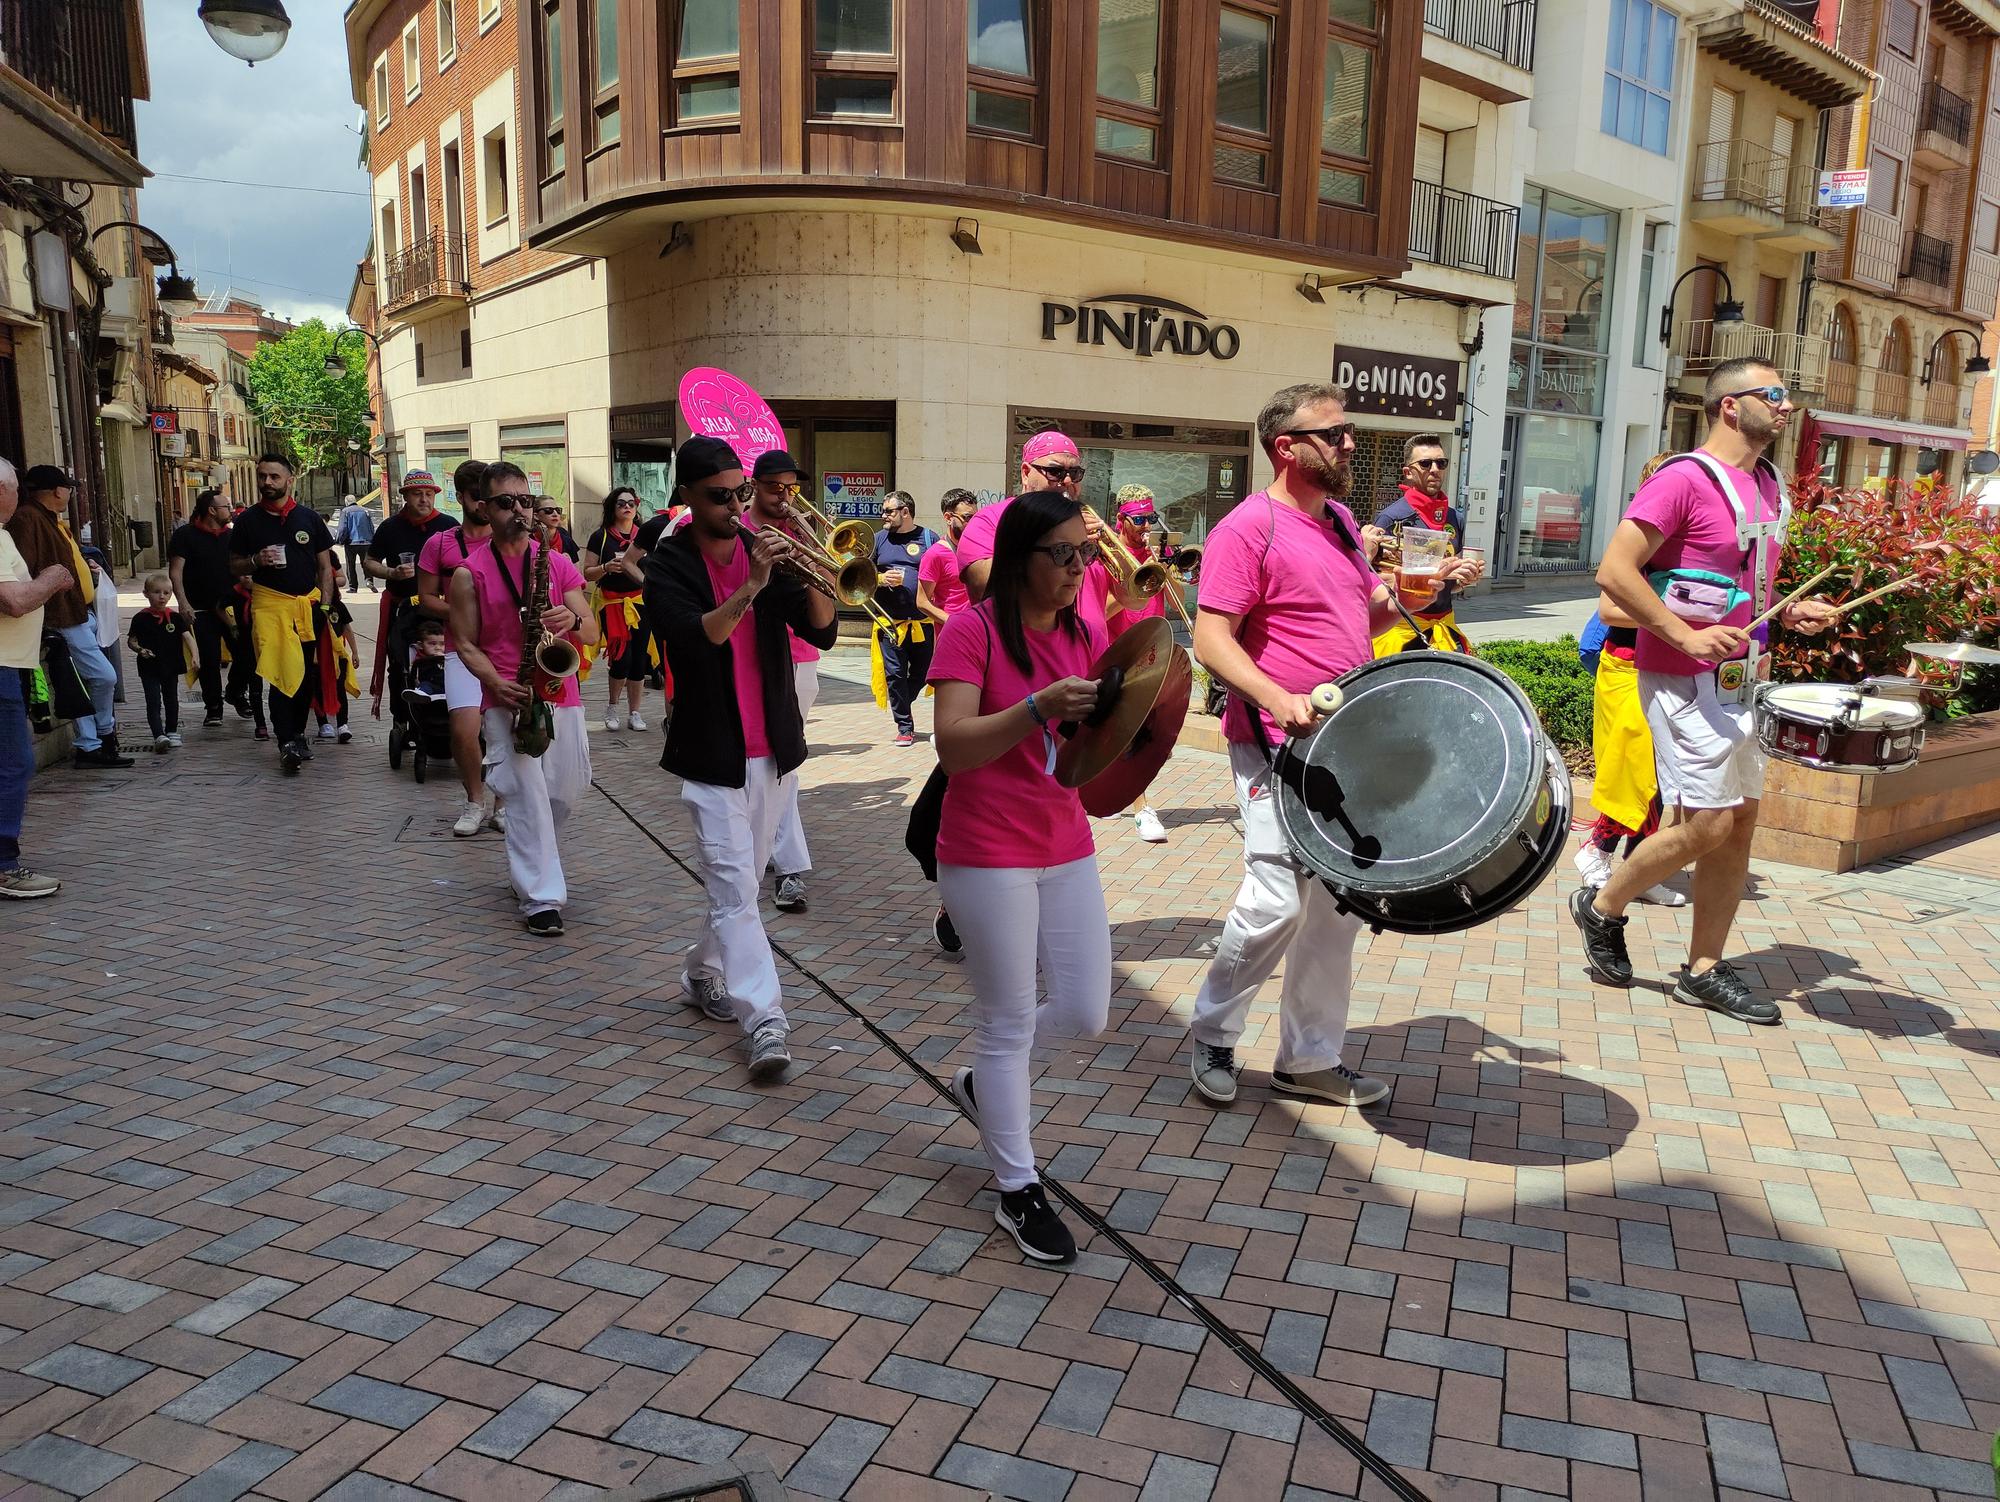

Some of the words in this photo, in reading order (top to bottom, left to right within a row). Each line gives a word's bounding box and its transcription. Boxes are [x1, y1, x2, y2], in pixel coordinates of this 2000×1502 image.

[1832, 181, 1866, 189] RE/MAX
[1041, 294, 1240, 360] PINTADO
[1338, 361, 1446, 400] DeNIÑOS
[1540, 370, 1586, 395] DANIEL
[700, 416, 736, 433] SALSA
[747, 427, 776, 443] ROSA
[845, 477, 883, 485] ALQUILA
[848, 487, 877, 496] RE/MAX
[845, 503, 856, 514] 26
[858, 503, 869, 514] 50
[872, 503, 884, 514] 60
